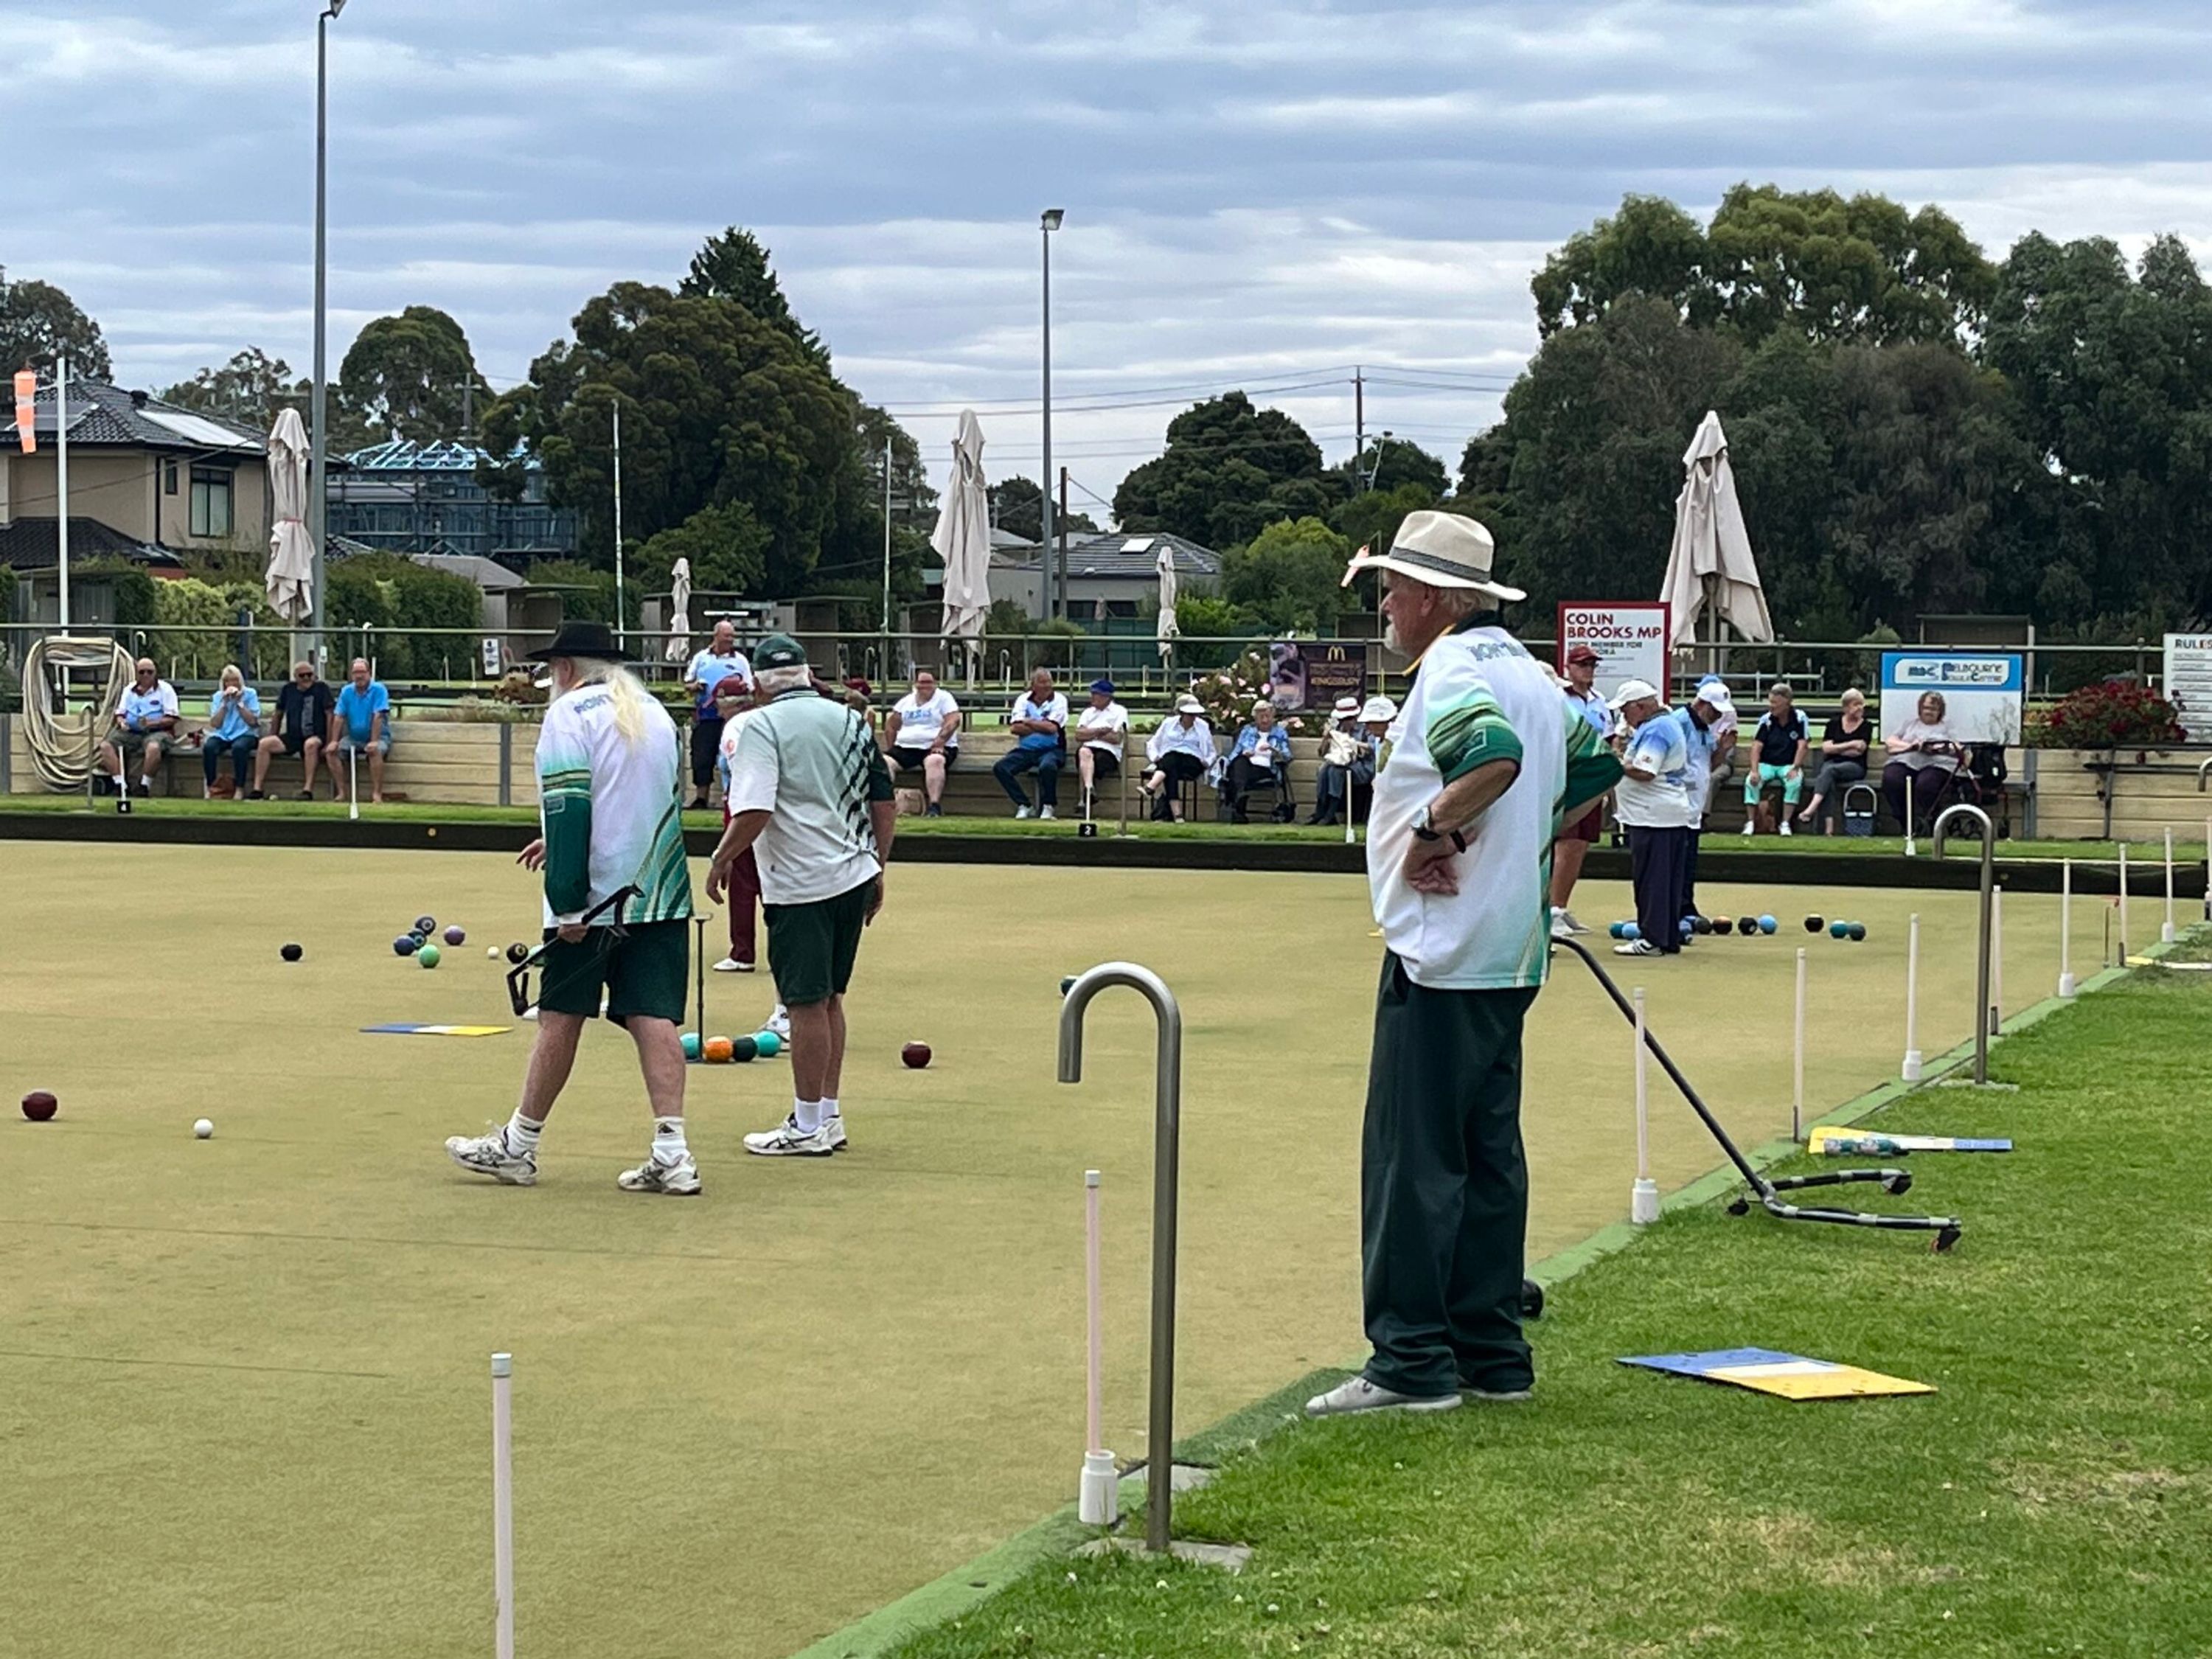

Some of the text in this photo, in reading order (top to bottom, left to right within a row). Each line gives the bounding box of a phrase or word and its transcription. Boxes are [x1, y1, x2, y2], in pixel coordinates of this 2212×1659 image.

[1567, 613, 1613, 625] COLIN
[1567, 627, 1661, 639] BROOKS MP
